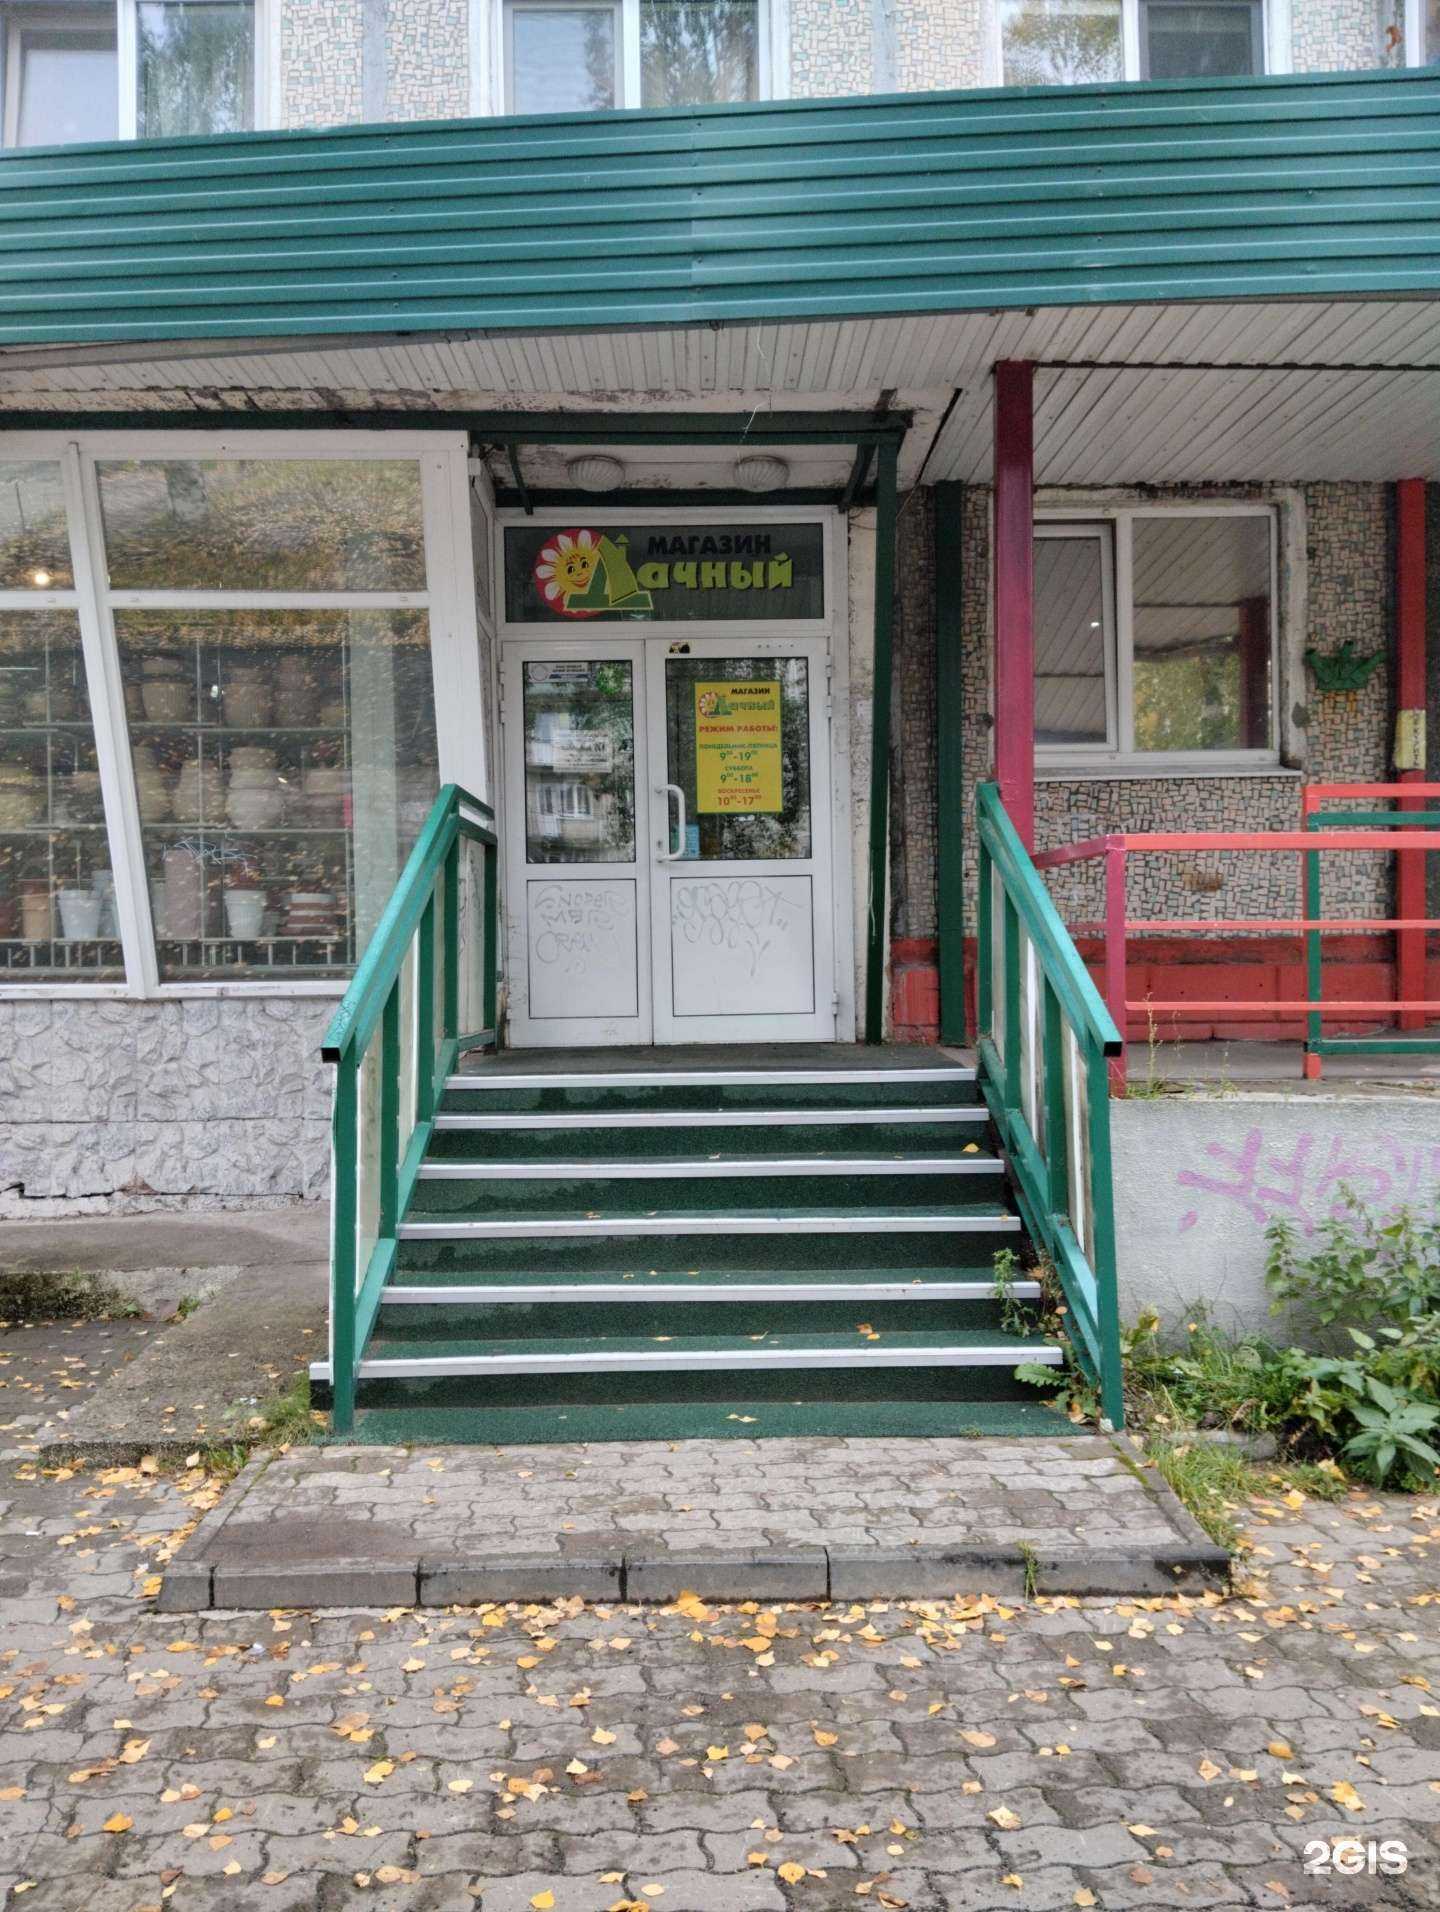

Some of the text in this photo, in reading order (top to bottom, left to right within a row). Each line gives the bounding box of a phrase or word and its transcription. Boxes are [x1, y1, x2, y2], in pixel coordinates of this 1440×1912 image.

[647, 533, 772, 555] МАГАЗИН
[731, 687, 771, 695] МАГАЗИН
[698, 725, 735, 733] РЕЖИМ
